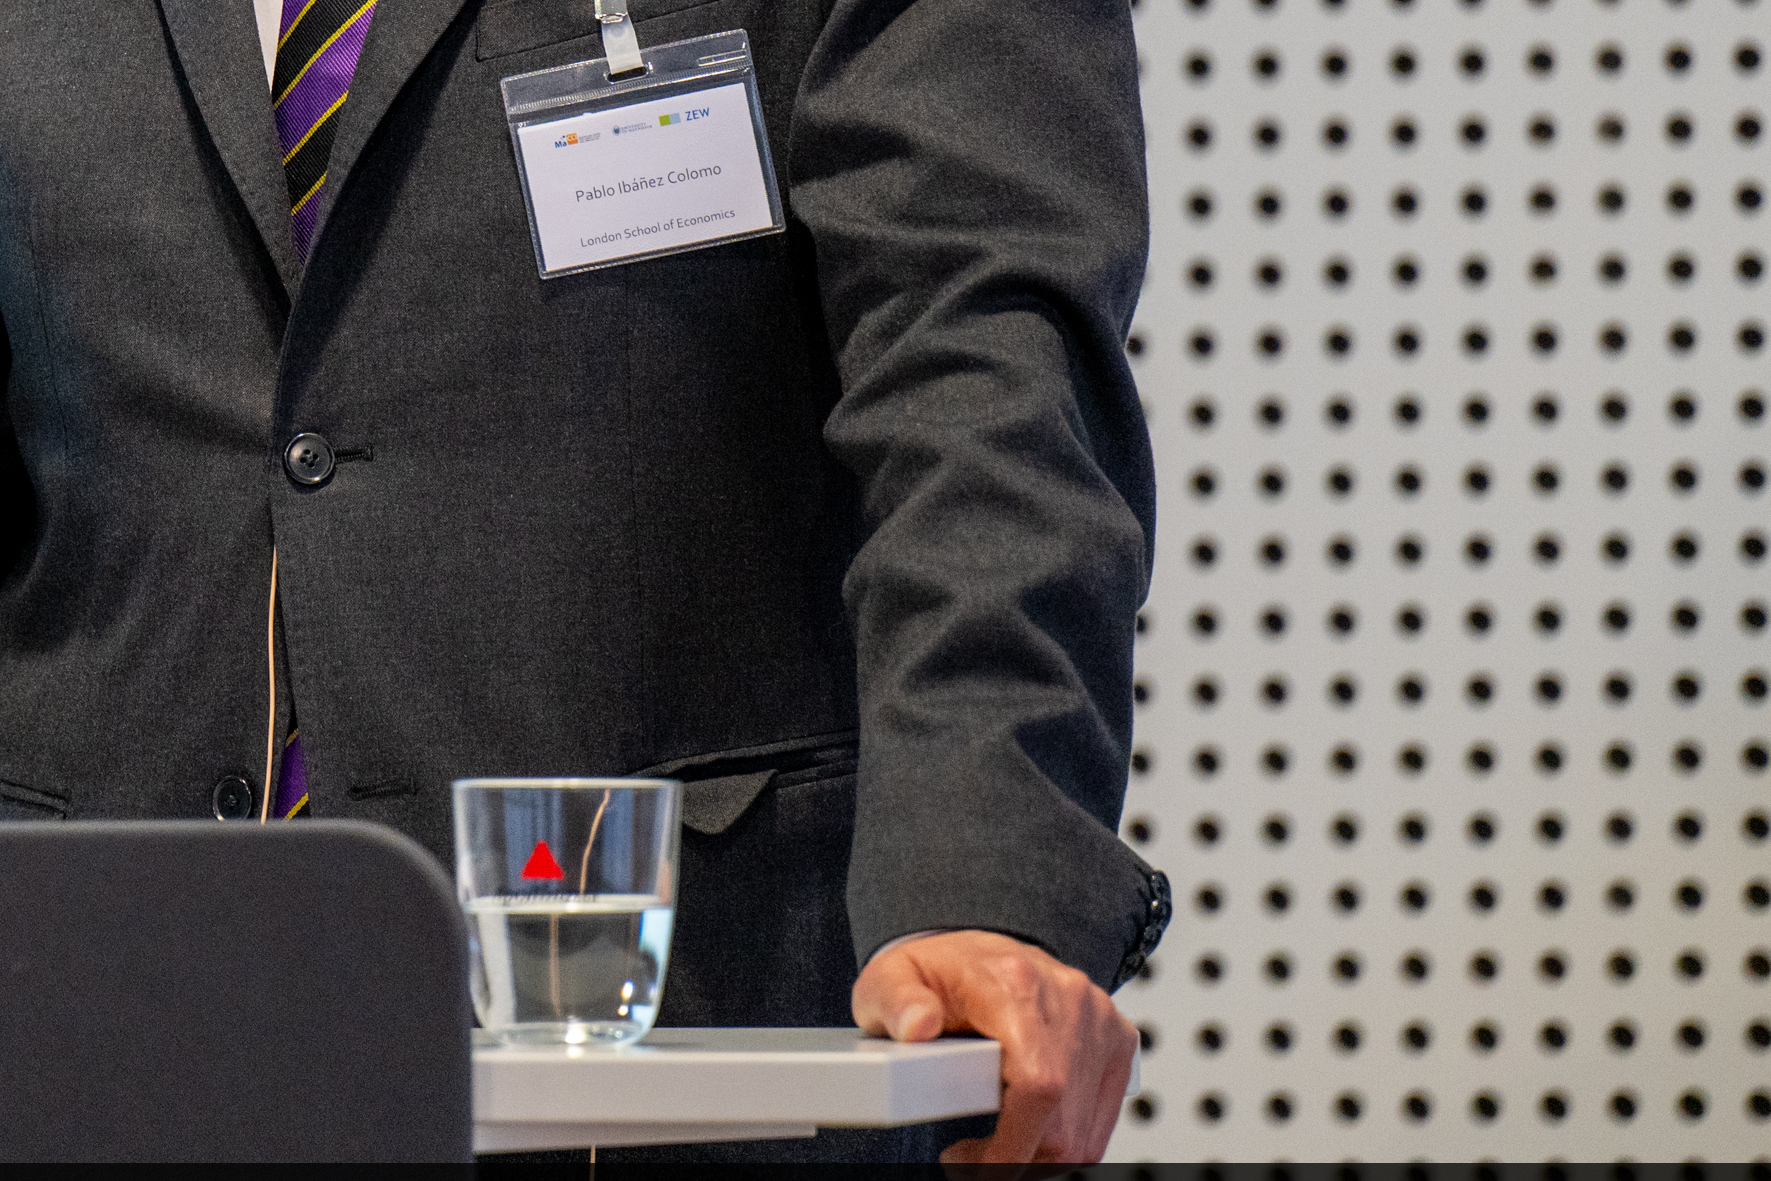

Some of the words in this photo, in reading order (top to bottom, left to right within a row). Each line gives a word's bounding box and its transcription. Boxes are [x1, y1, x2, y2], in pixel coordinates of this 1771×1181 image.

[685, 107, 710, 121] ZEW
[575, 185, 615, 203] Pablo
[618, 177, 664, 195] Ibáñez
[667, 165, 722, 184] Colomo
[580, 231, 622, 248] London
[624, 222, 661, 239] School
[663, 220, 674, 231] of
[676, 209, 736, 229] Economics
